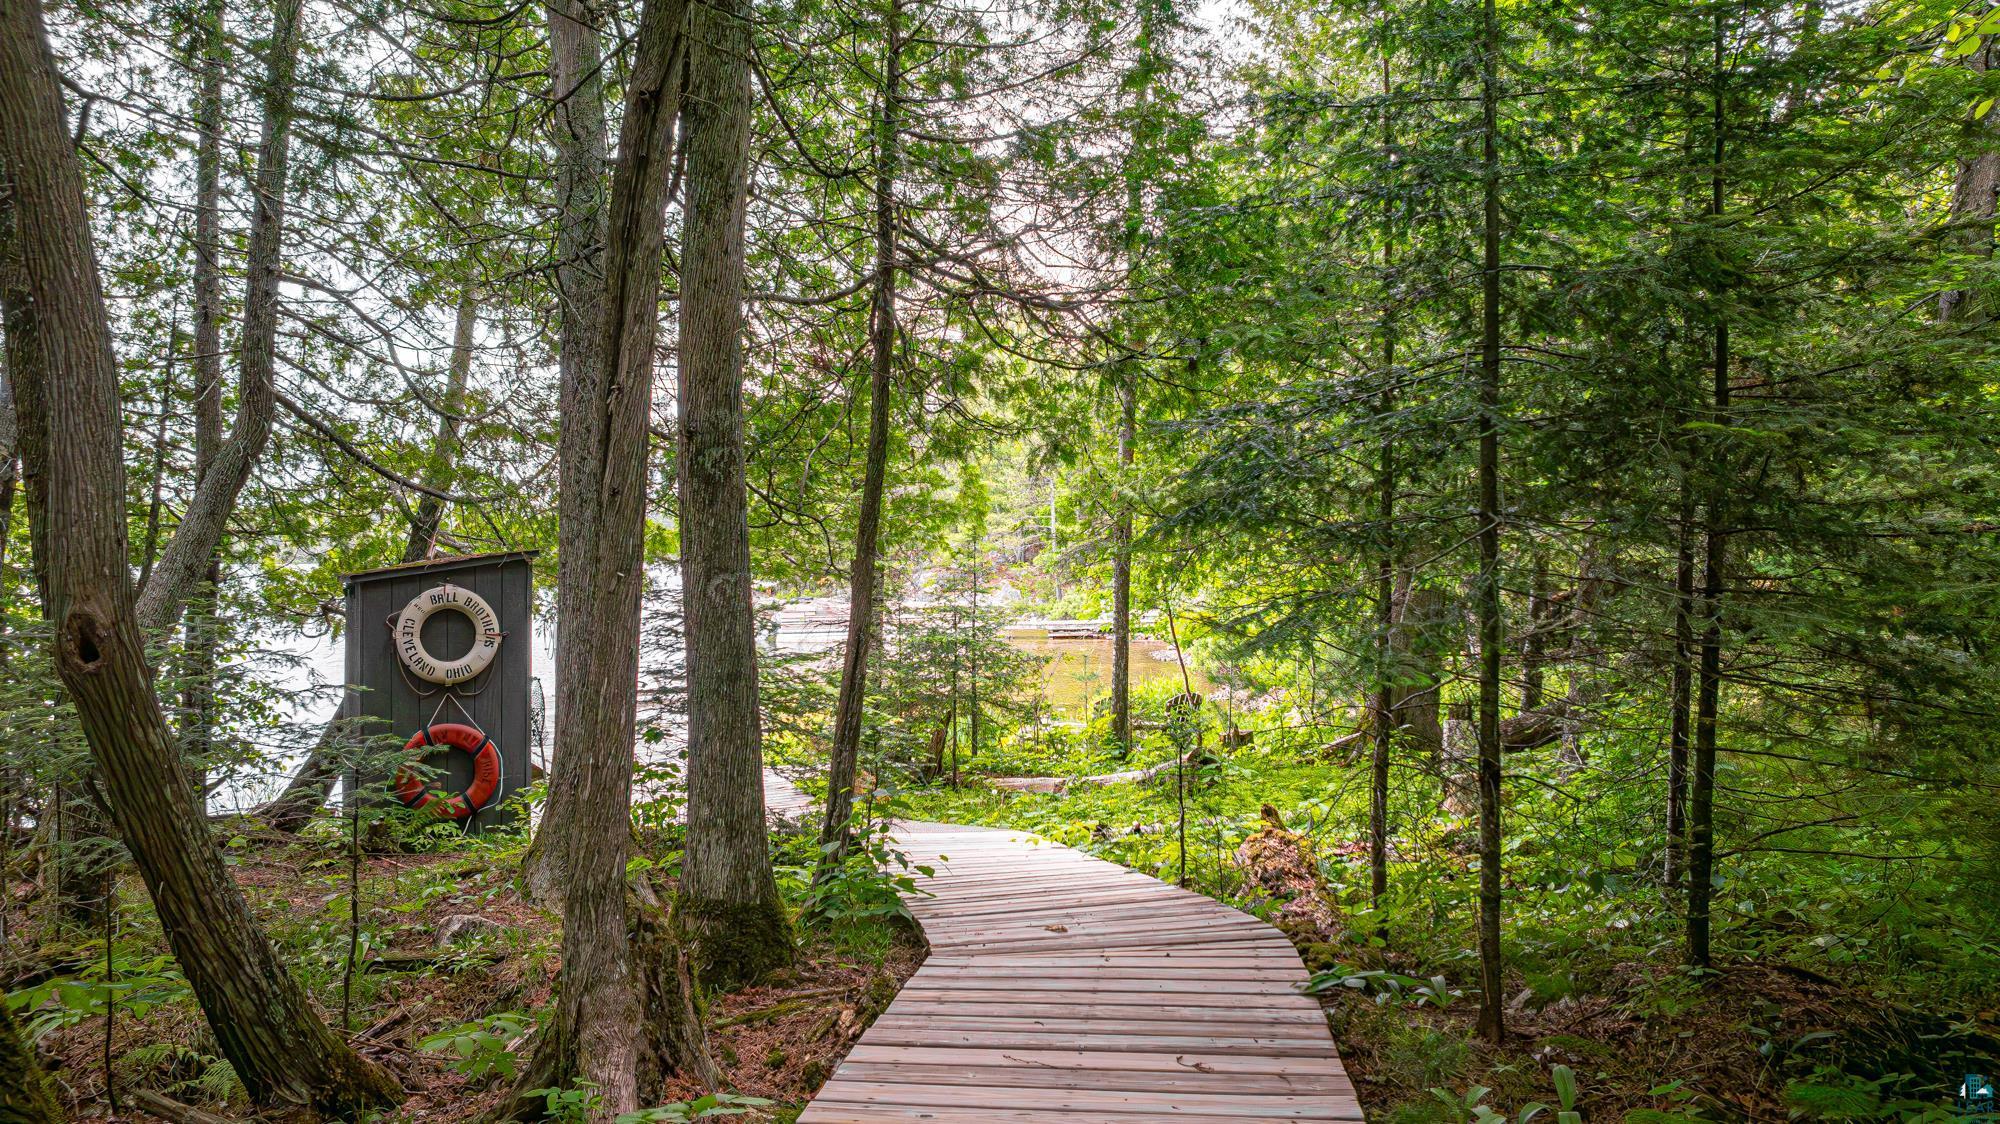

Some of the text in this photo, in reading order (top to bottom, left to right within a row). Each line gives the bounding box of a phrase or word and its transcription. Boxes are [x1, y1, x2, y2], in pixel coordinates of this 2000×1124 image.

[402, 618, 473, 679] CLEVELAND OHIO
[429, 592, 495, 649] BALL BROTHERS
